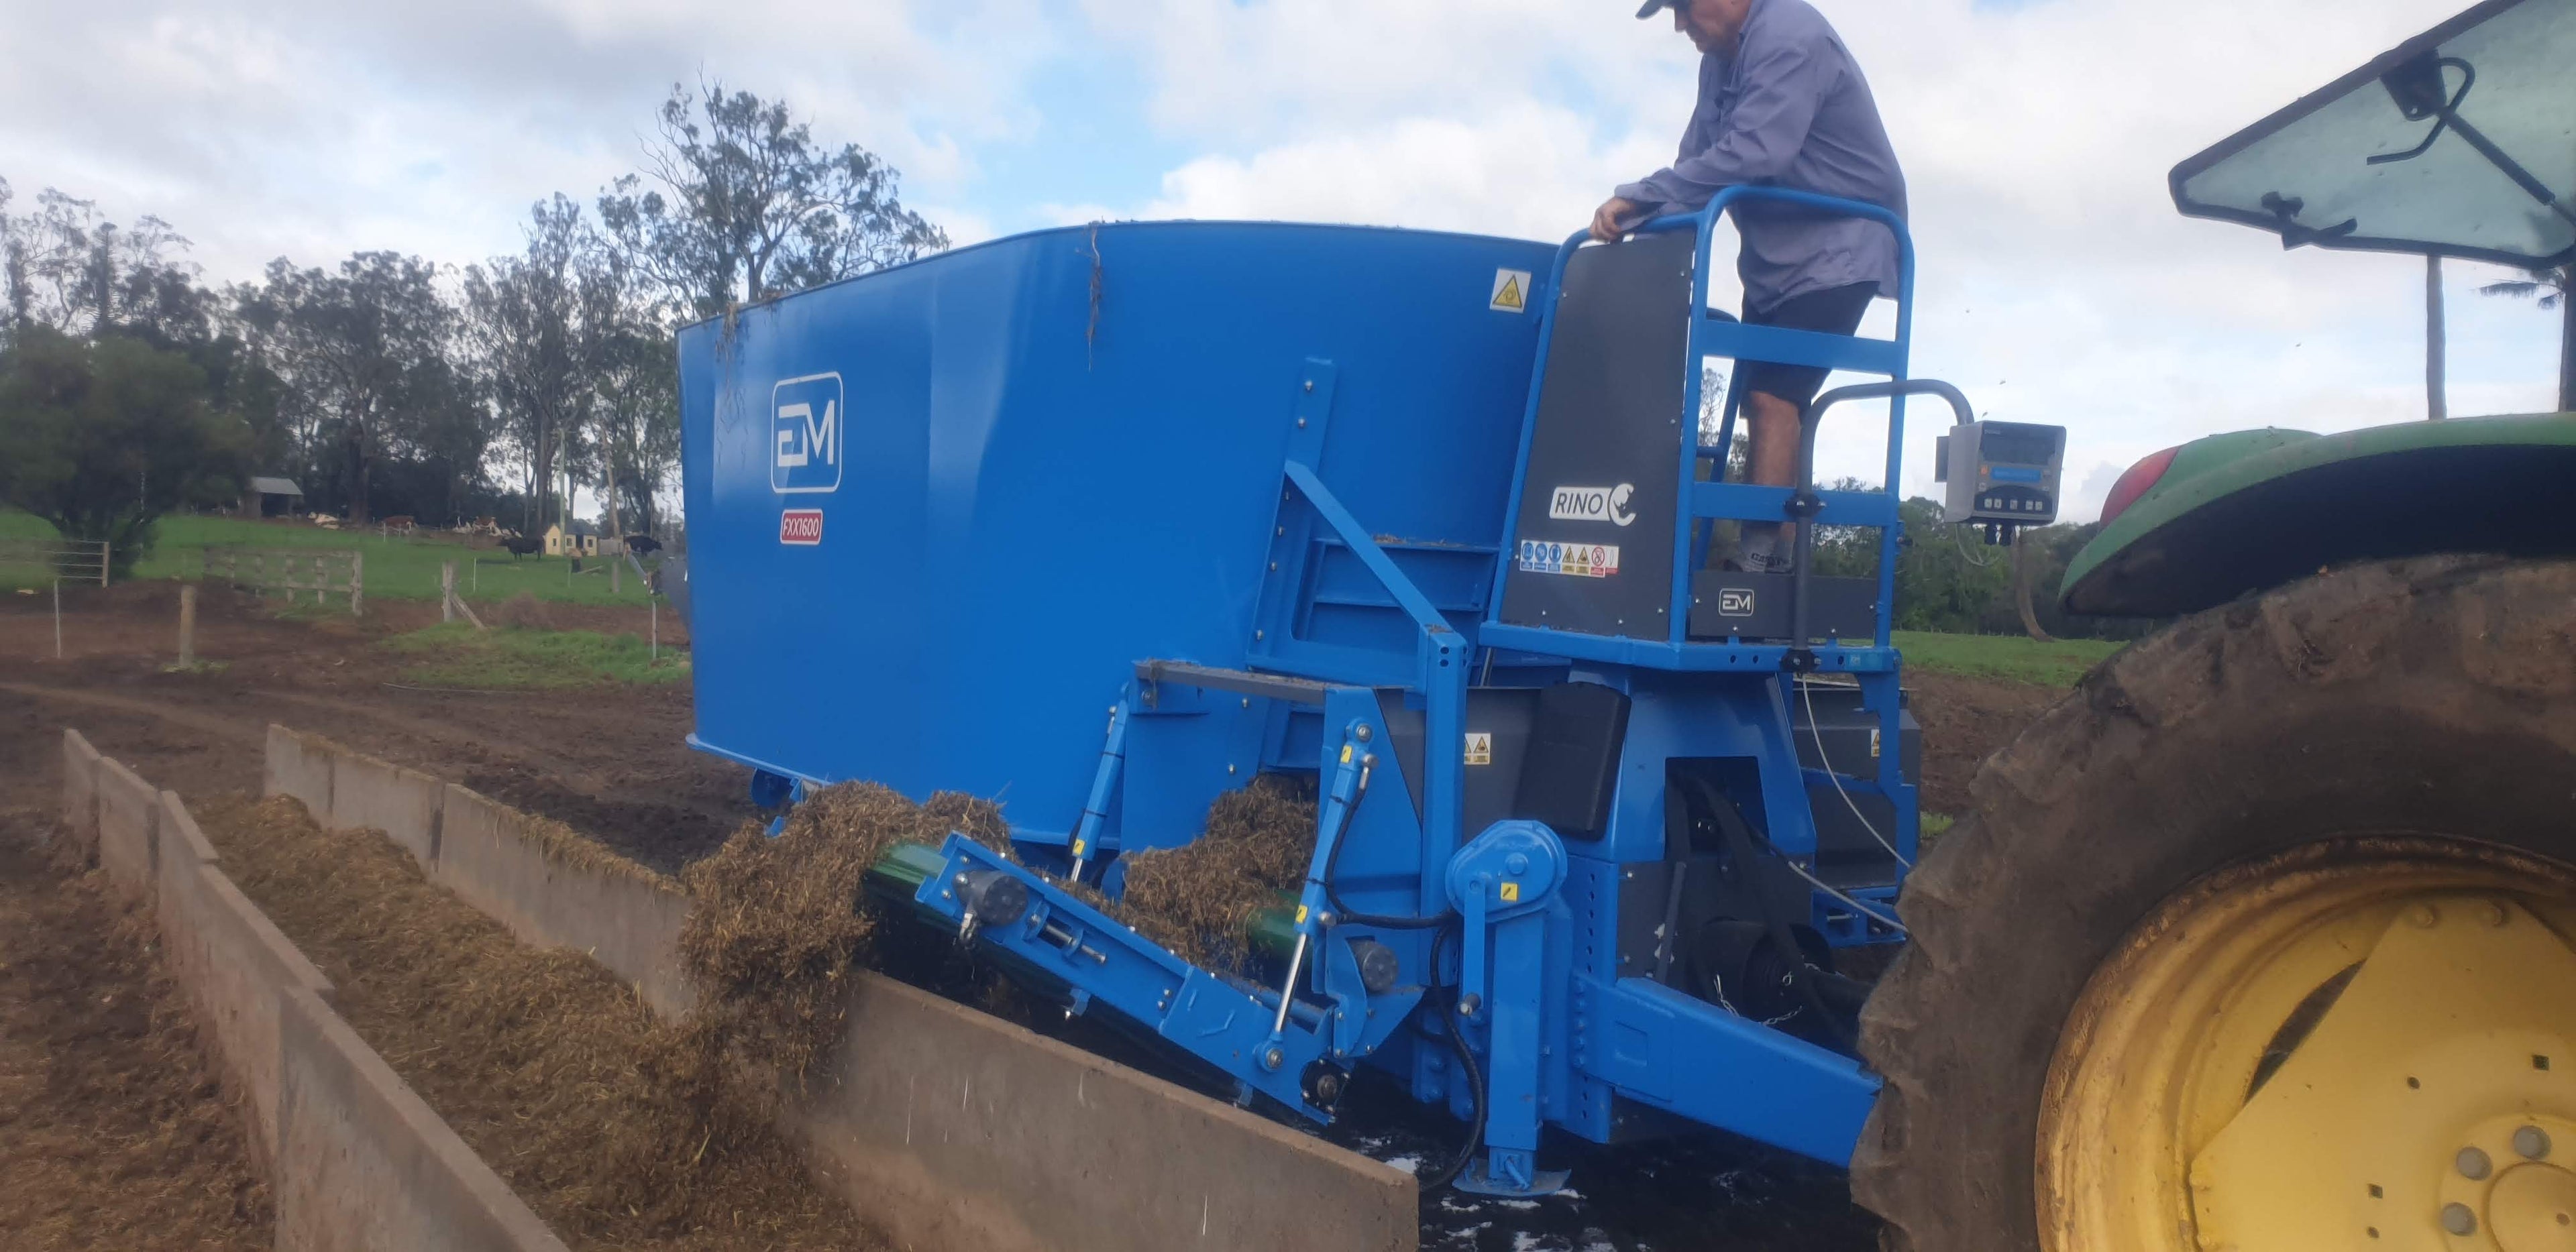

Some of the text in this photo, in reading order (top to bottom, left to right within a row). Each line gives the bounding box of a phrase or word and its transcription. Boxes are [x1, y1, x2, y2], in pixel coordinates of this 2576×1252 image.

[777, 399, 835, 467] EM
[1554, 493, 1603, 514] RINO
[783, 517, 820, 537] FXX1600
[1722, 594, 1751, 610] EM
